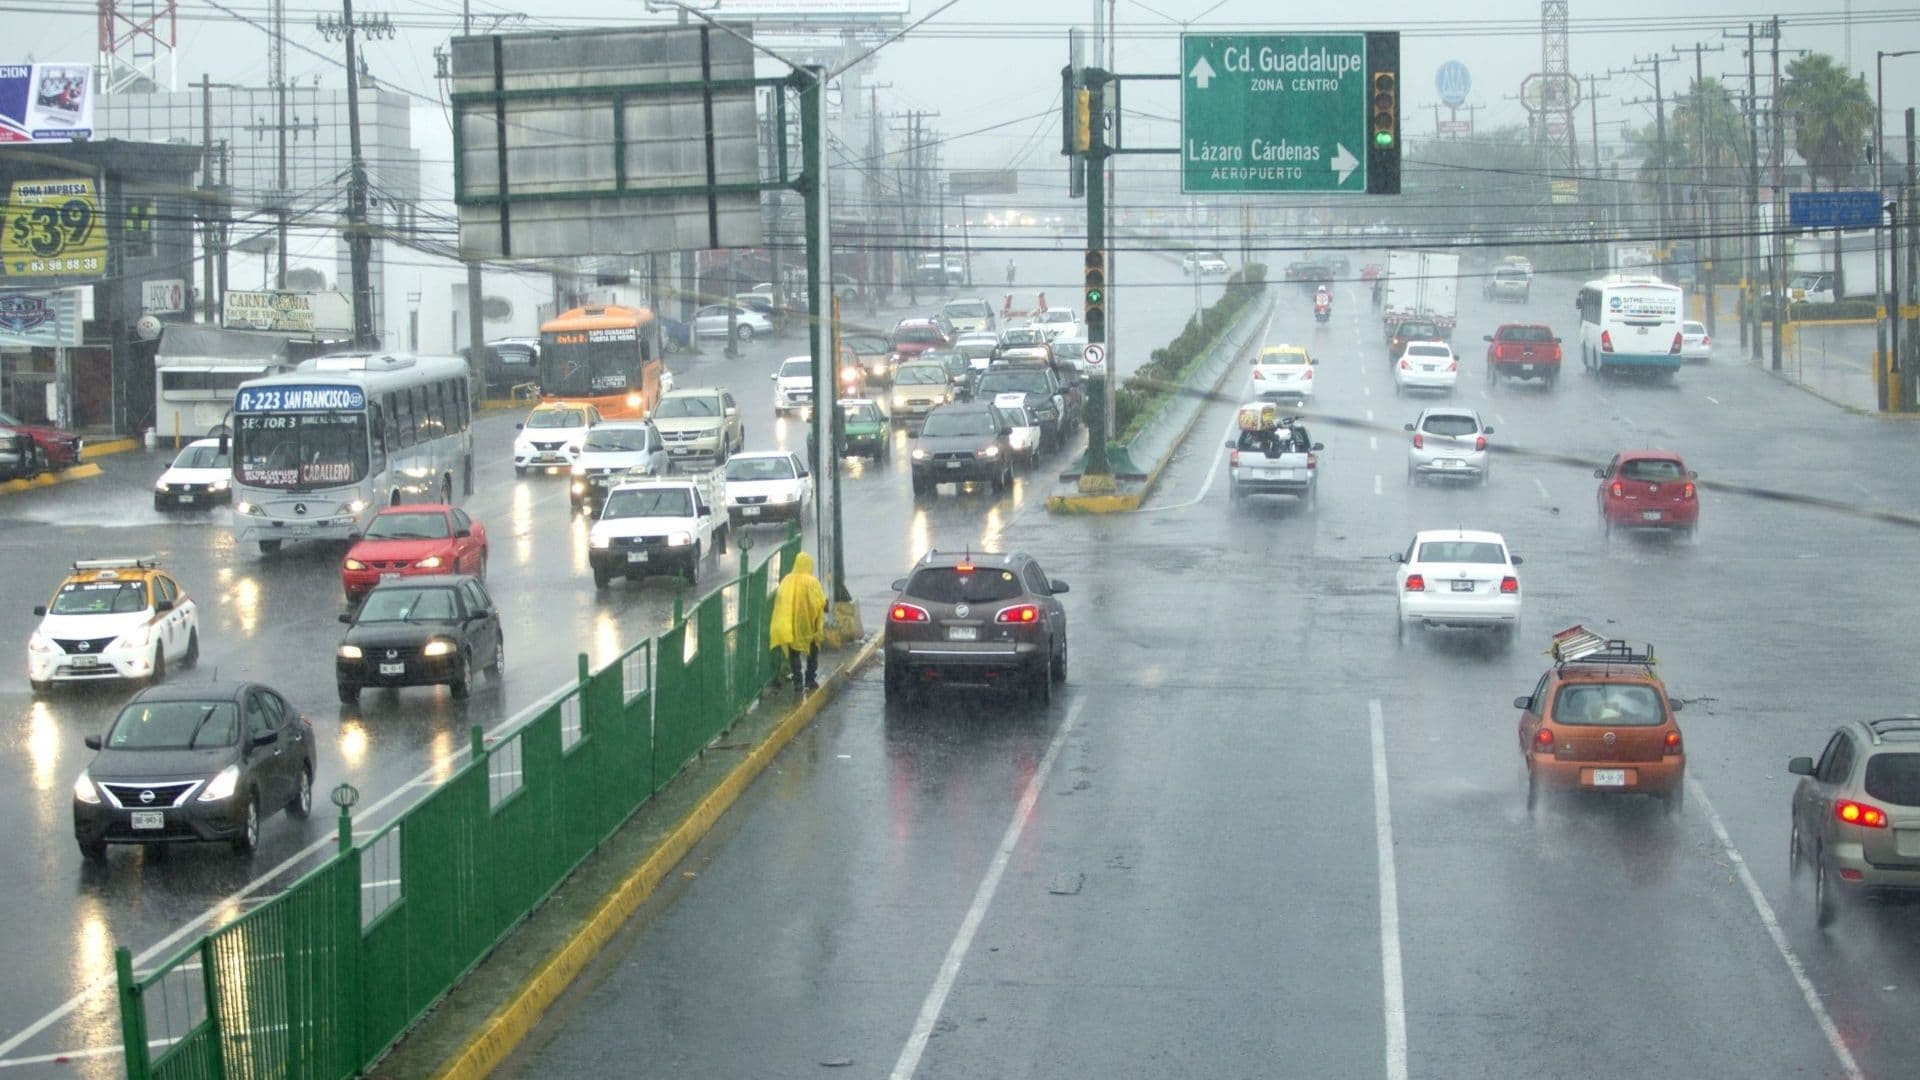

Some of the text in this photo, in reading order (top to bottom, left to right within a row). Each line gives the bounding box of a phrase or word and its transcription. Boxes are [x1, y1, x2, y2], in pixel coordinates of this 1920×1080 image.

[1224, 47, 1361, 79] Cd. Guadalupe
[1250, 79, 1338, 91] ZONA CENTRO
[1189, 138, 1320, 161] Lázaro Cárdenas
[1210, 167, 1303, 180] AEROPUERTO
[18, 185, 87, 197] LONA IMPRESA
[229, 293, 310, 311] CARNE ASADA
[241, 392, 280, 410] R-223
[284, 391, 301, 409] SAN
[302, 390, 350, 409] FRANCISCO
[288, 417, 296, 428] 3
[303, 463, 350, 481] CABALLERO
